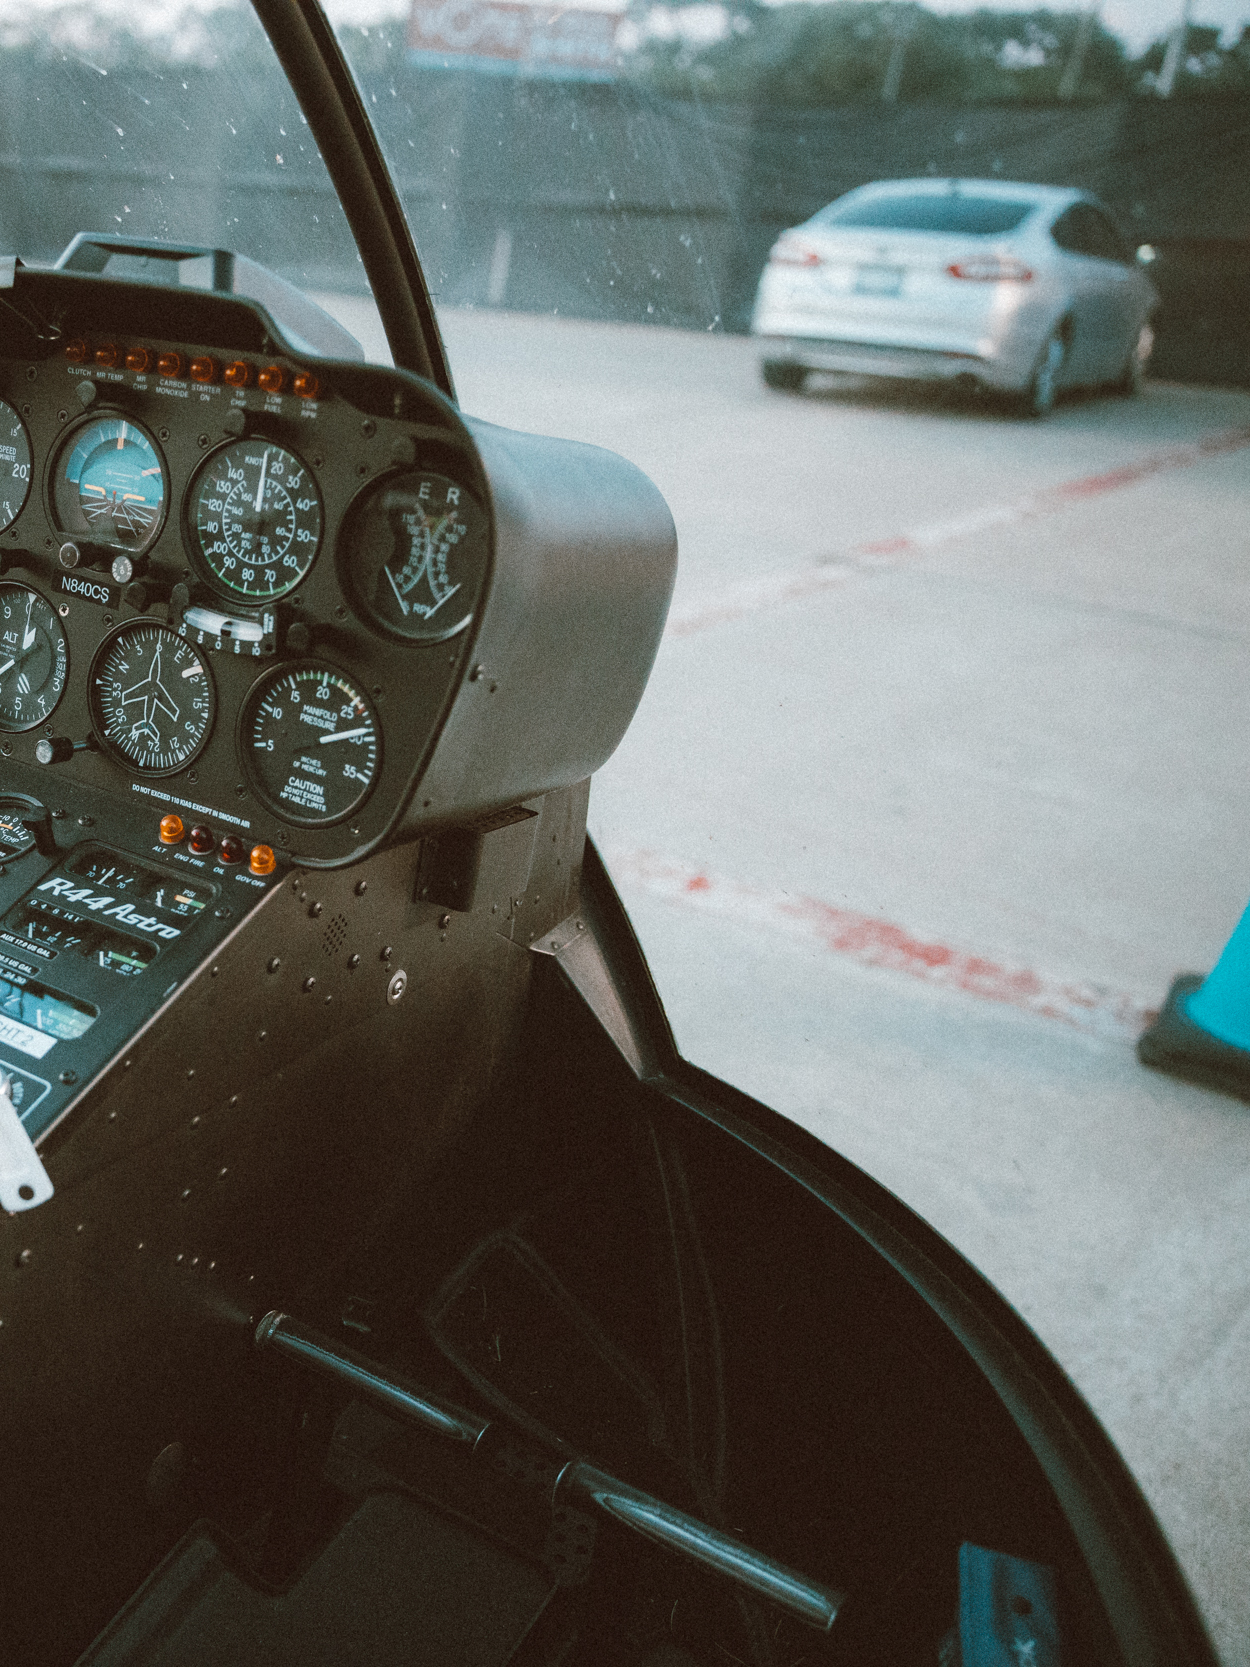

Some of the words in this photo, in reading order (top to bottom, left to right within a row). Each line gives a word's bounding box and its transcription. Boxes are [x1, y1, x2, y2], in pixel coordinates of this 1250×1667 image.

[67, 366, 92, 377] CLUTCH
[155, 386, 189, 399] MONOXIDE
[10, 428, 19, 437] 15
[0, 444, 17, 456] SPEED
[0, 453, 16, 463] MINUTE
[11, 462, 27, 479] 20
[228, 468, 244, 481] 140
[270, 462, 284, 475] 20
[216, 480, 231, 493] 130
[286, 476, 300, 489] 30
[419, 481, 432, 499] E
[446, 487, 460, 505] R
[2, 501, 10, 509] 15
[208, 499, 223, 512] 120
[296, 498, 310, 511] 40
[206, 521, 219, 534] 110
[296, 528, 311, 543] 50
[213, 541, 228, 555] 100
[223, 555, 236, 569] 90
[283, 554, 297, 568] 60
[241, 567, 255, 581] 80
[264, 569, 276, 582] 70
[61, 576, 110, 603] N840CS
[4, 606, 12, 619] 9
[2, 630, 19, 644] ALT
[178, 626, 187, 637] 10
[56, 638, 65, 653] 2
[135, 645, 144, 656] 3
[215, 640, 222, 650] 0
[252, 646, 261, 656] 10
[174, 650, 185, 664] E
[118, 660, 130, 674] N
[52, 677, 61, 692] 3
[112, 682, 122, 698] 33
[290, 690, 300, 703] 15
[316, 685, 330, 700] 20
[14, 696, 22, 710] 5
[37, 694, 46, 707] 4
[192, 697, 202, 709] 15
[115, 708, 127, 724] 30
[272, 707, 283, 720] 10
[302, 704, 338, 722] MANIFOLD
[340, 705, 354, 719] 25
[184, 721, 195, 733] S
[299, 713, 337, 732] PRESSURE
[147, 740, 160, 752] 24
[170, 736, 180, 750] 21
[266, 739, 275, 752] 5
[301, 763, 327, 777] MERCURY
[342, 764, 357, 779] 35
[288, 776, 324, 796] CAUTION
[284, 784, 293, 794] DO
[292, 787, 303, 797] NOT
[302, 790, 325, 804] EXCEED
[132, 783, 140, 792] DO
[139, 785, 151, 795] NOT
[151, 789, 171, 802] EXCEED
[179, 798, 193, 809] KIAS
[192, 801, 213, 816] EXCEPT
[218, 811, 241, 826] SMOOTH
[240, 818, 250, 829] AIR
[288, 793, 306, 806] TABLE
[305, 798, 327, 812] LIMITS
[1, 834, 20, 844] TEMP
[152, 845, 167, 854] ALT
[173, 852, 189, 863] ENG
[188, 857, 206, 868] FIRE
[213, 866, 225, 875] OIL
[234, 874, 252, 884] GOV
[250, 878, 267, 888] OFF
[182, 889, 196, 898] PSI
[37, 877, 116, 911] R44
[102, 903, 182, 940] Astro
[63, 912, 74, 920] 14
[0, 933, 16, 943] AUX
[27, 943, 38, 952] US
[36, 947, 51, 958] GAL
[8, 958, 20, 967] US
[18, 963, 33, 974] GAL
[20, 1034, 35, 1046] 2
